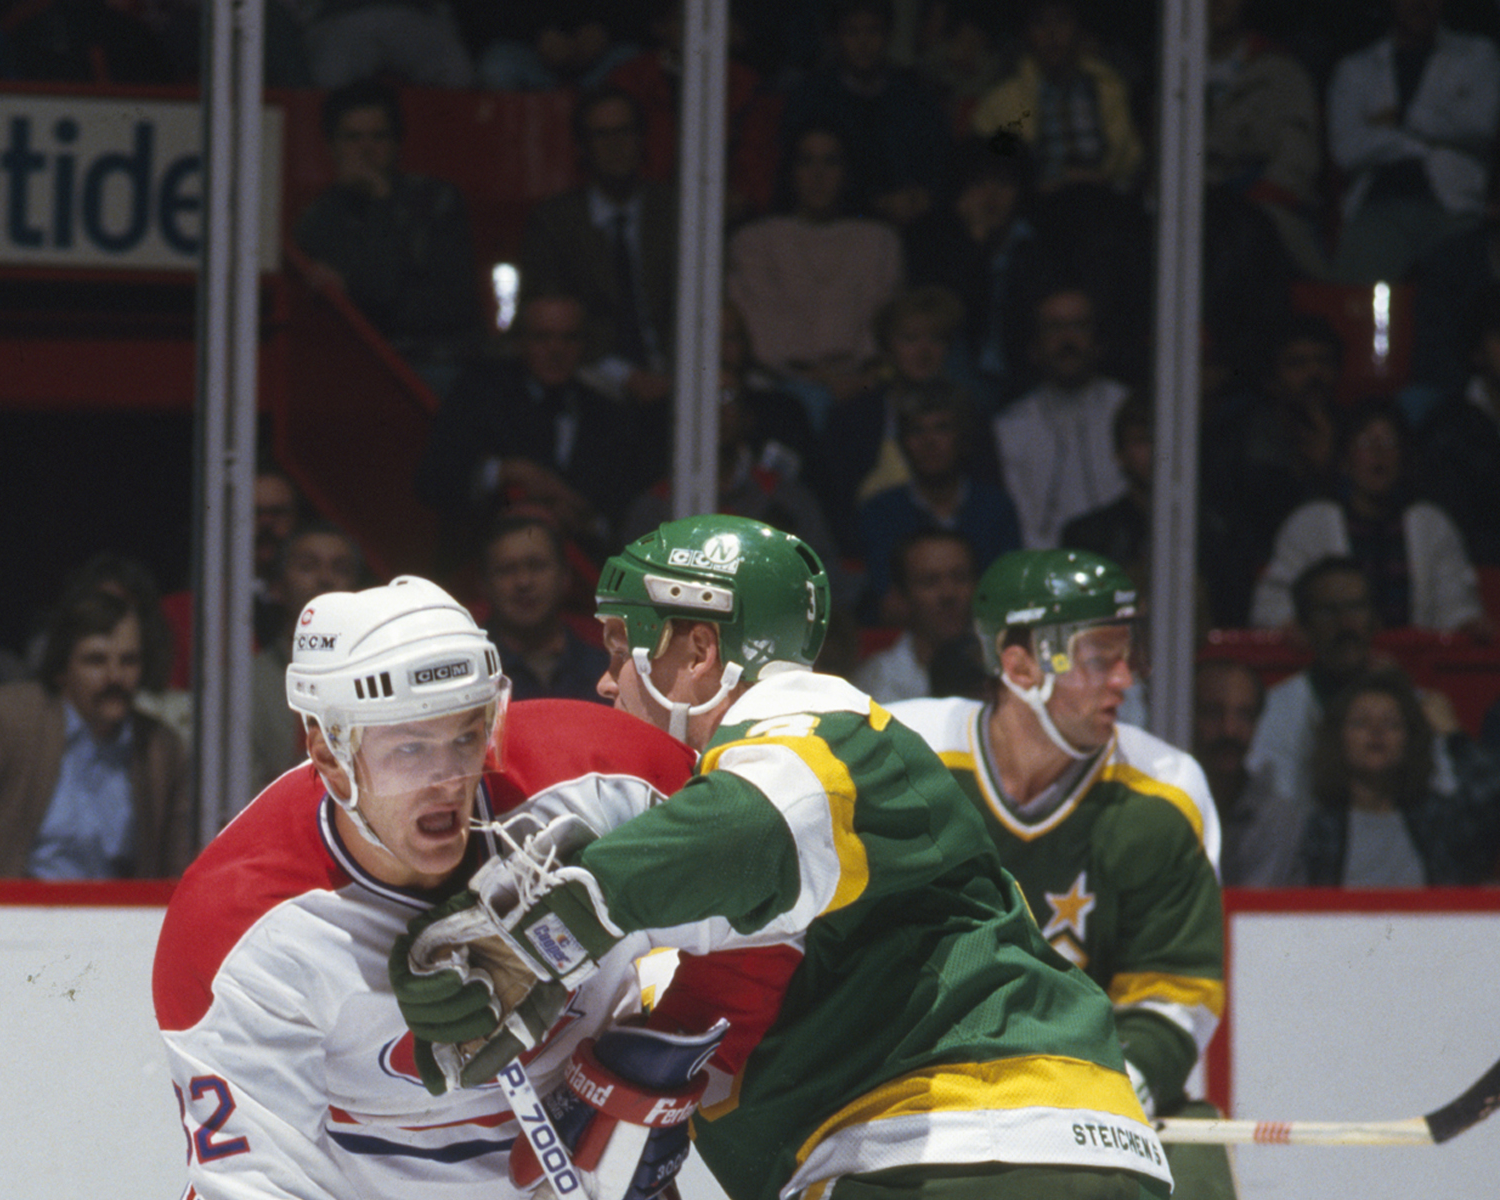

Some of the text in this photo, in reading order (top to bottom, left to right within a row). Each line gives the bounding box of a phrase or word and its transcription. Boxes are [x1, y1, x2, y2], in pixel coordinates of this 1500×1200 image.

[805, 580, 817, 622] 3
[297, 633, 337, 650] CCM
[415, 661, 469, 685] CCM
[520, 1102, 578, 1195] 7000
